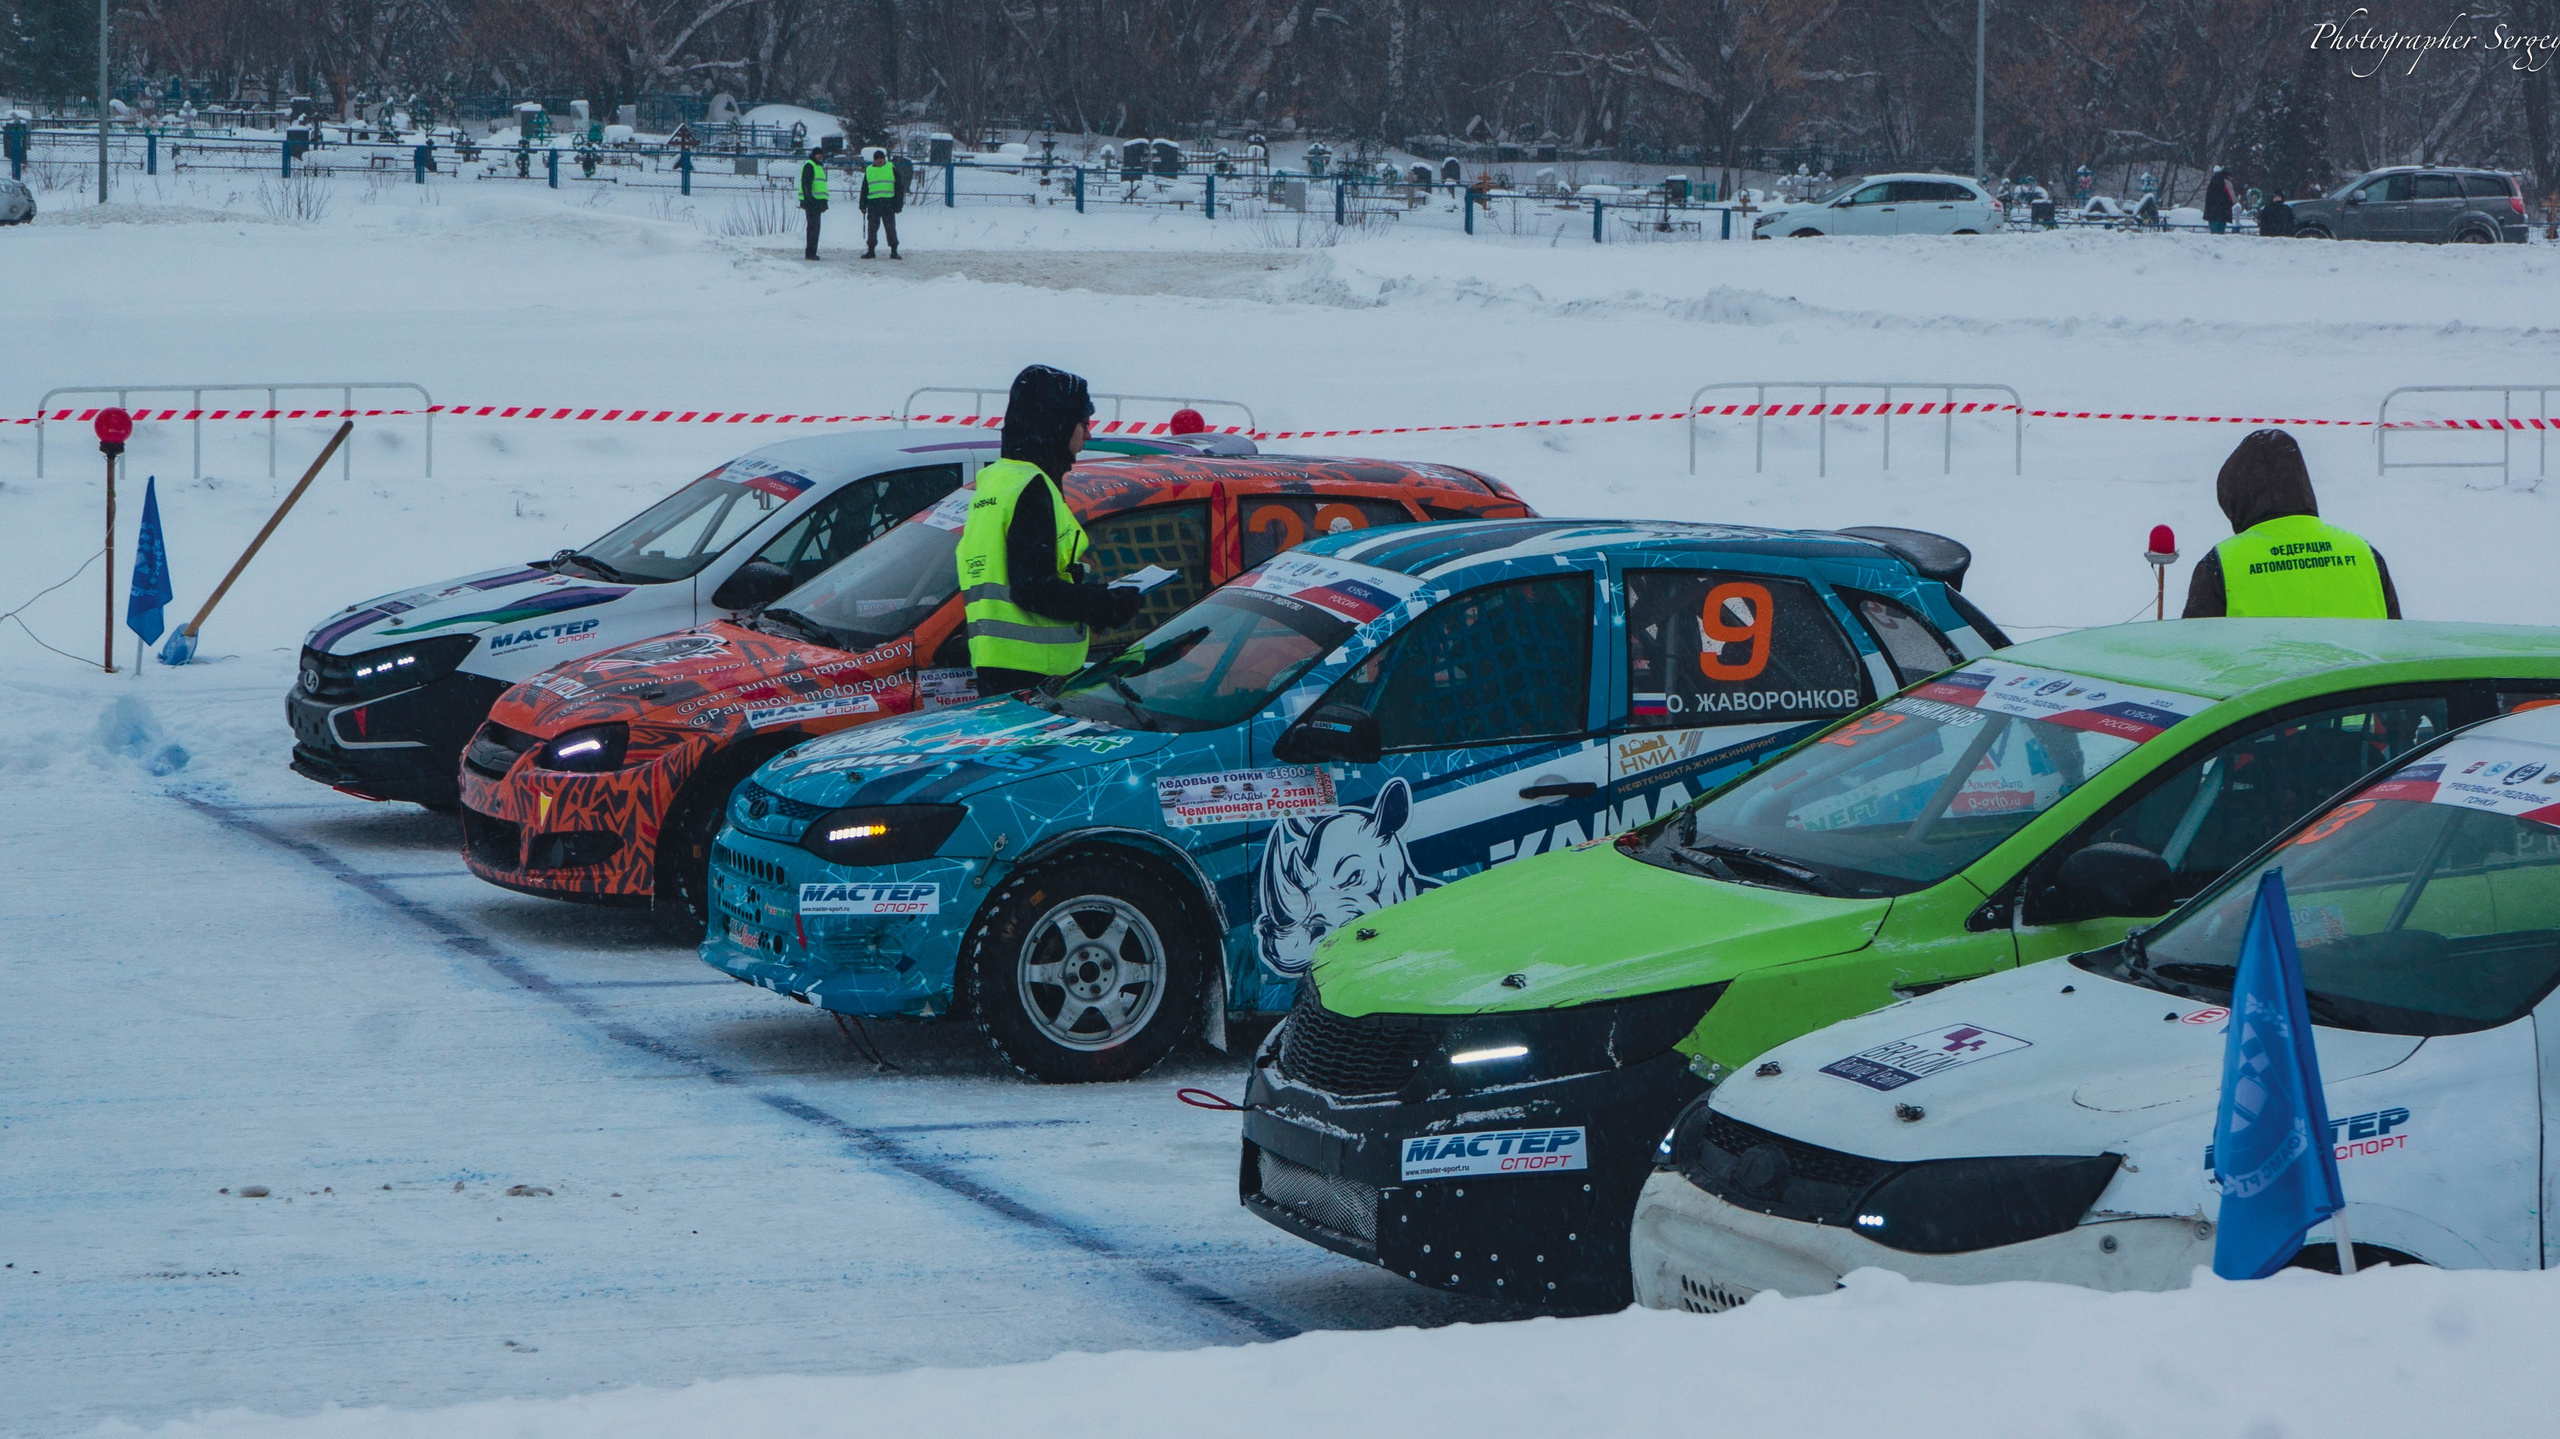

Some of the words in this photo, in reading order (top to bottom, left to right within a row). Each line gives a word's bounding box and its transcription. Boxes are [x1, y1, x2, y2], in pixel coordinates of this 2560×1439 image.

[2270, 541, 2333, 556] ФЕДЕРАЦИЯ
[2249, 556, 2343, 575] АВТОМОТОСПОРТА
[2345, 555, 2356, 566] РТ
[1347, 585, 1372, 598] КУБОК
[1329, 595, 1361, 609] РОССИИ
[490, 618, 600, 650] МАСТЕР
[557, 632, 597, 645] СПОРТ
[1700, 582, 1773, 681] 9
[677, 640, 914, 716] @car_tuning_laboratory
[751, 696, 872, 721] МАСТЕР
[1666, 694, 1690, 713] О.
[1697, 689, 1860, 712] ЖАВОРОНКОВ
[1999, 703, 2027, 712] ГОНКИ
[2150, 700, 2174, 708] 2022
[825, 704, 869, 716] СПОРТ
[2122, 709, 2160, 721] КУБОК
[2098, 718, 2143, 732] РОССИИ
[1617, 736, 1777, 794] НЕФТЕМОНТАЖИНЖИНИРИНГ
[1619, 746, 1677, 776] НМИ
[1223, 771, 1263, 783] гонки
[1271, 787, 1280, 799] 2
[1283, 786, 1315, 798] этап
[2446, 782, 2492, 795] ТРЕКОВЫЕ
[2497, 789, 2552, 805] ЛЕДОВЫЕ
[1176, 801, 1263, 818] Чемпионата
[1267, 797, 1318, 811] России
[2463, 795, 2499, 807] ГОНКИ
[801, 884, 936, 902] МАСТЕР
[873, 902, 929, 913] СПОРТ
[1831, 1057, 1878, 1080] Racing
[1869, 1068, 1909, 1087] Team
[1405, 1130, 1581, 1162] МАСТЕР
[2333, 1135, 2408, 1161] СПОРТ
[1500, 1155, 1573, 1170] СПОРТ
[1405, 1165, 1470, 1177] www.master-sport.ru
